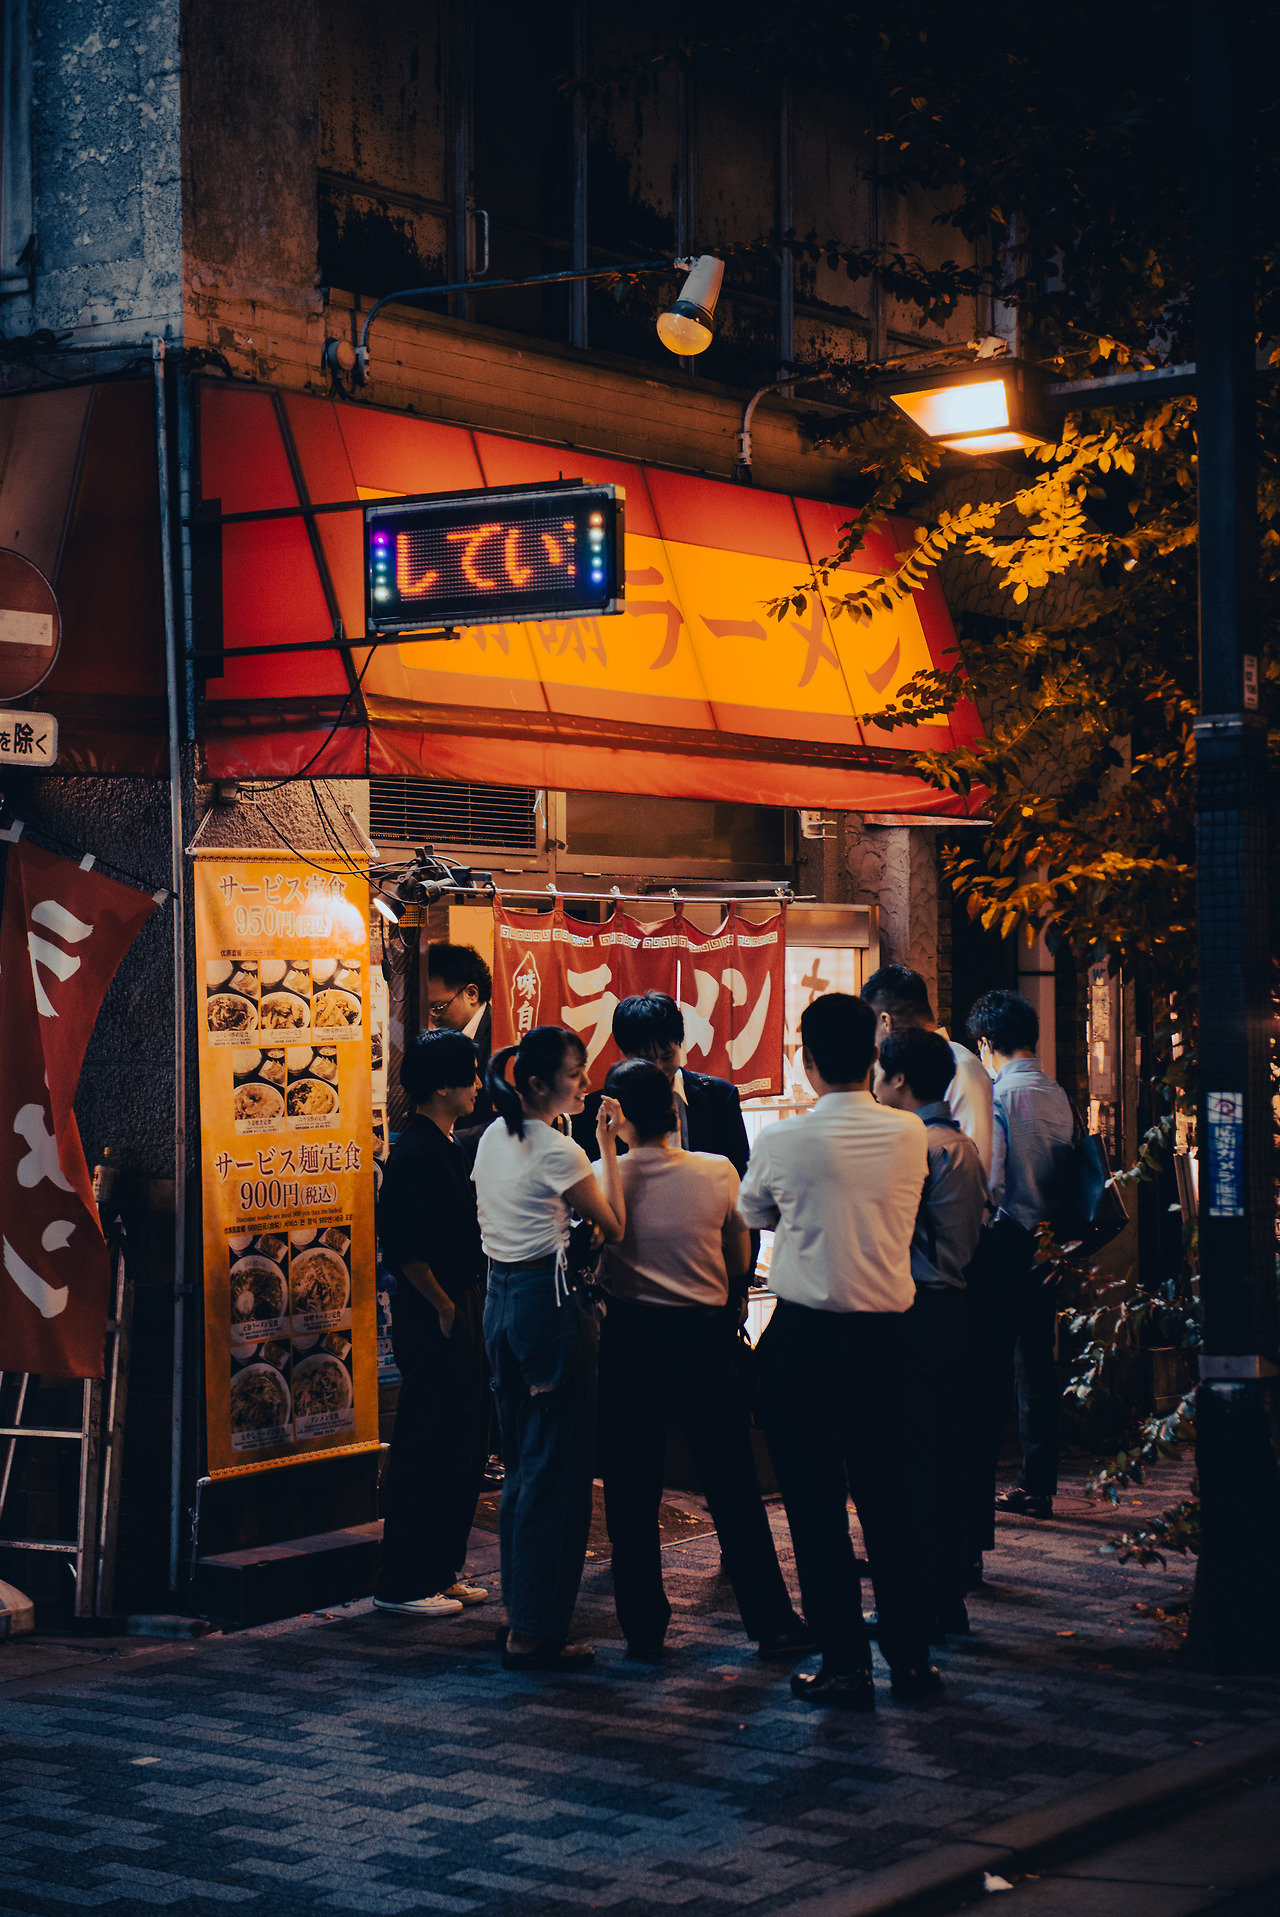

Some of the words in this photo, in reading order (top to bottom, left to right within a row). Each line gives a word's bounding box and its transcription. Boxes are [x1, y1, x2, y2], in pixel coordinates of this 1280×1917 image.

[396, 523, 576, 594] してい
[454, 566, 901, 694] ラーメン
[0, 722, 47, 754] を除く
[219, 875, 347, 906] サービス定食
[235, 906, 331, 936] 950円(税込)
[516, 968, 537, 1045] 味自
[561, 963, 770, 1070] ラメン
[3, 900, 94, 1318] ラメン
[215, 1141, 361, 1181] サービス麺定食
[240, 1177, 337, 1210] 900円(税込)
